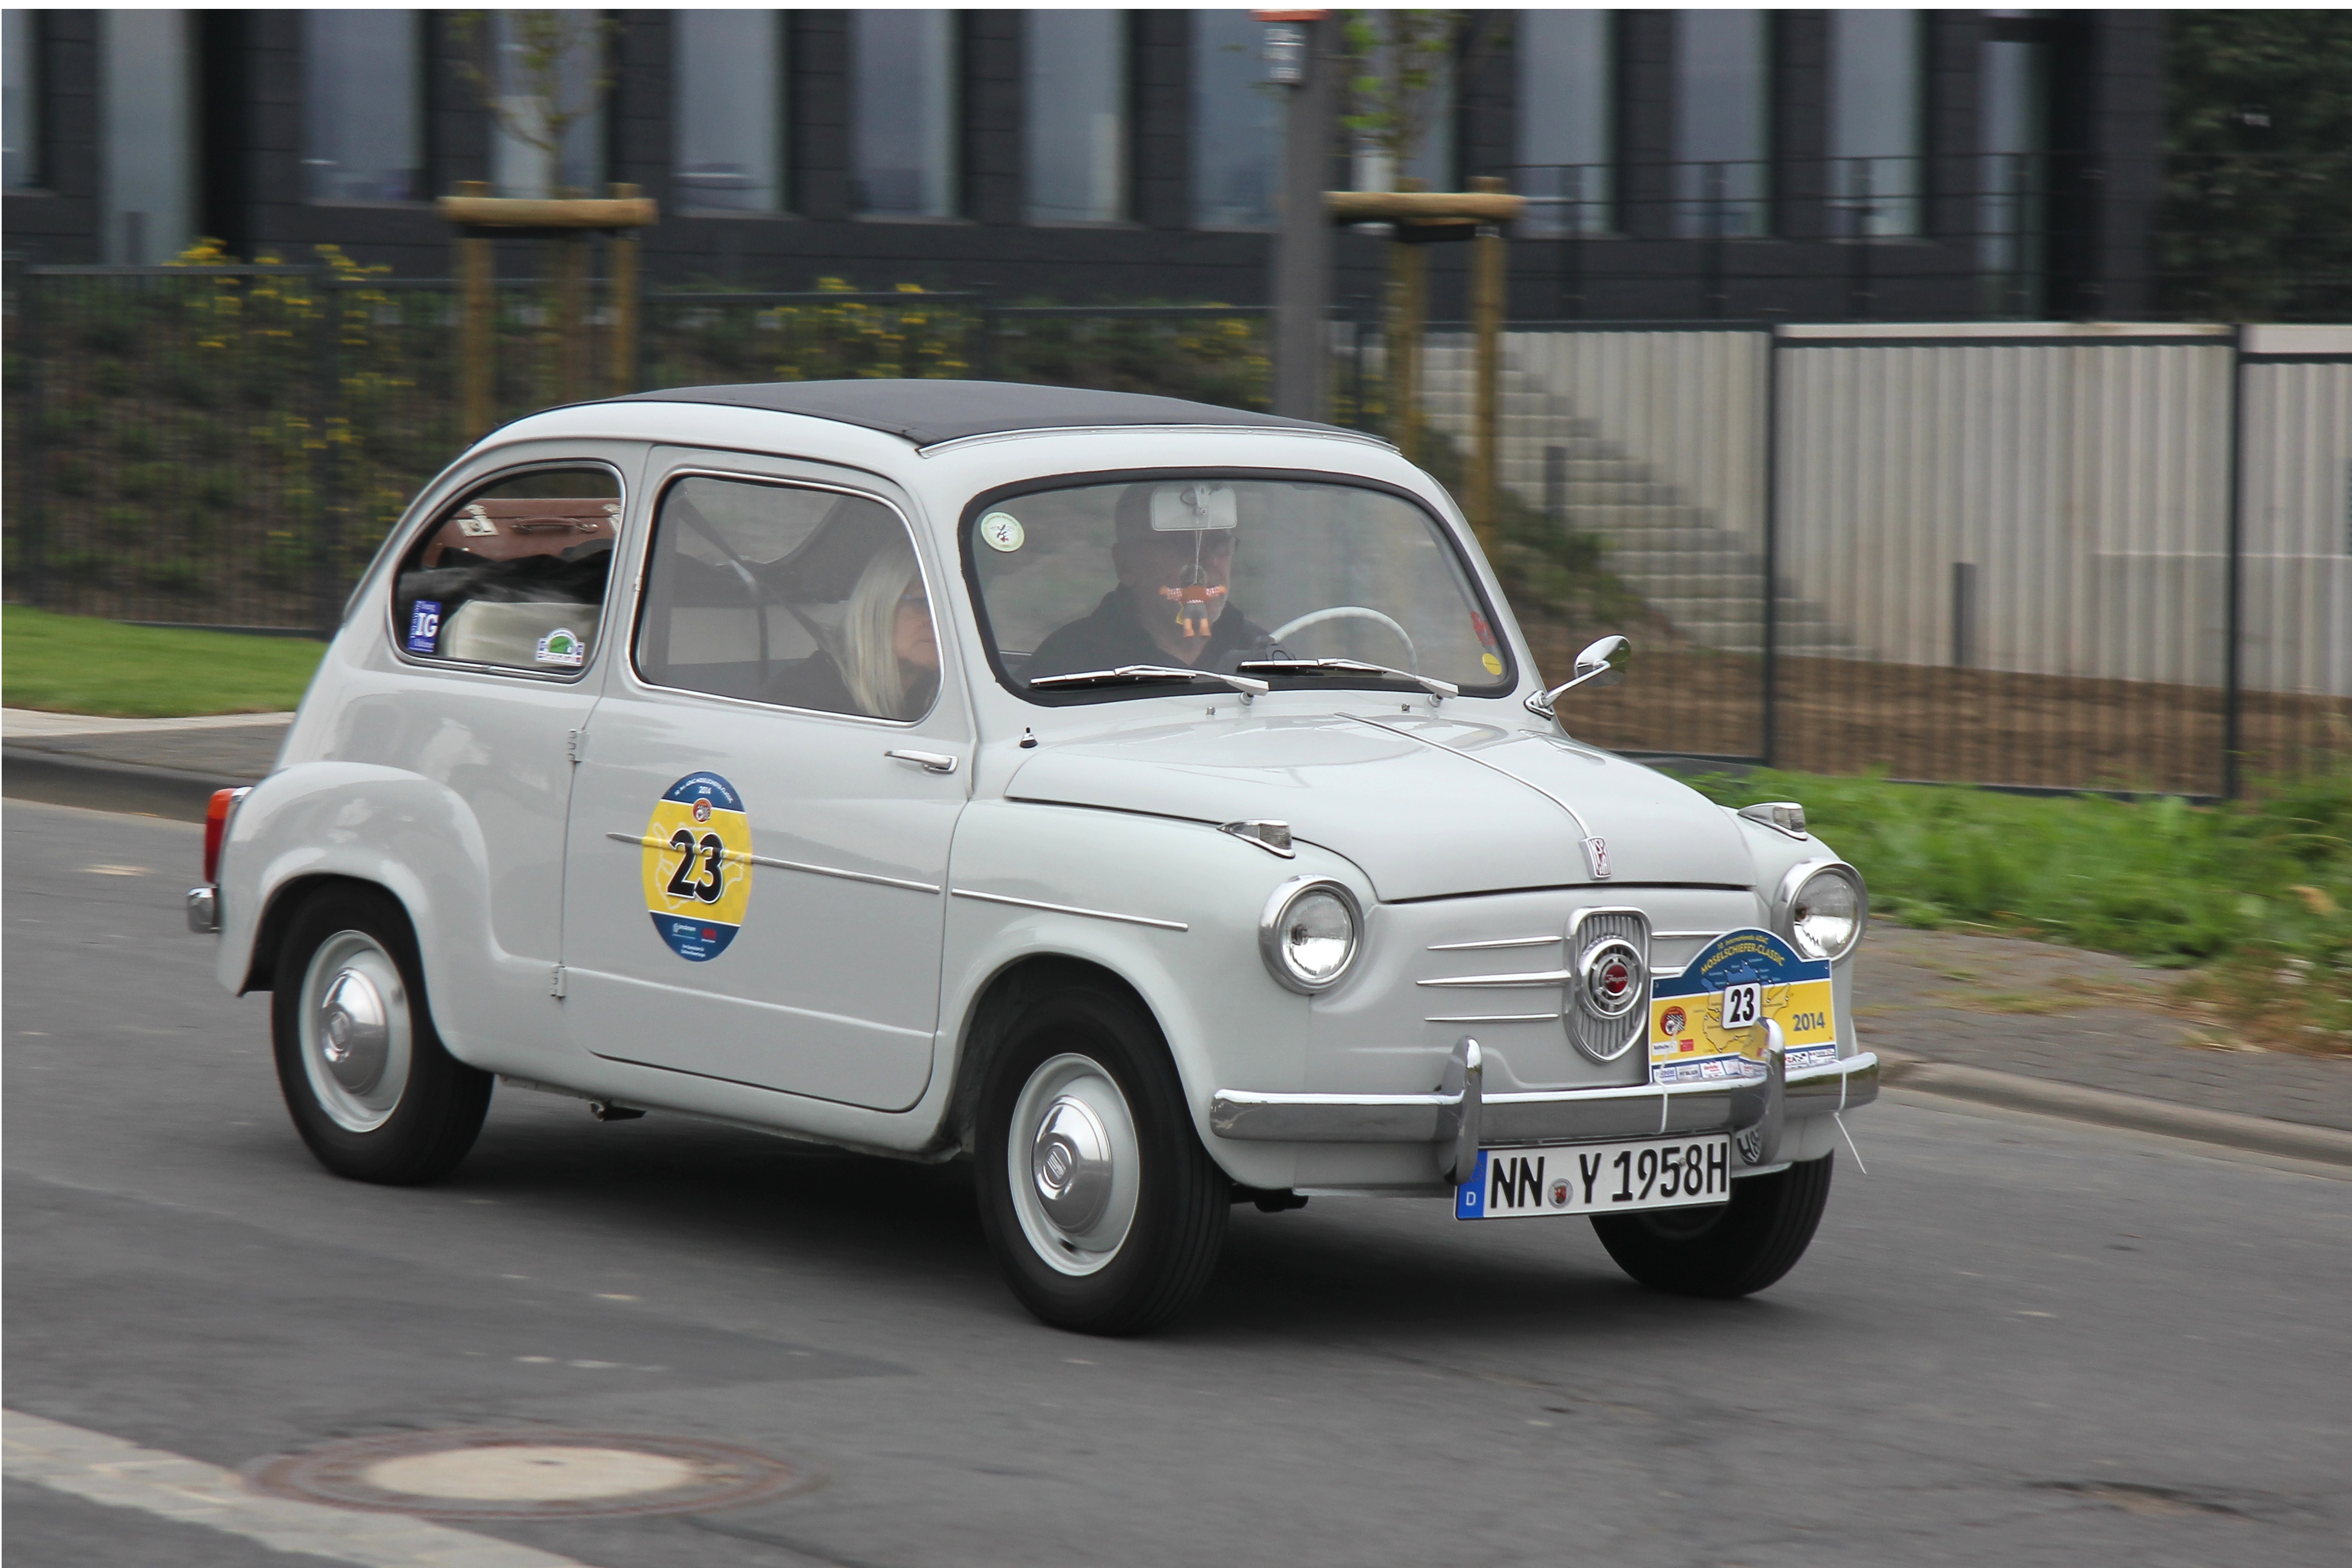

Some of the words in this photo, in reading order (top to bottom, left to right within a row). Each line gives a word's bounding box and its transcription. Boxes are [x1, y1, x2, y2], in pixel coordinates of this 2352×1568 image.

[416, 612, 439, 638] IG
[697, 786, 712, 795] 2014
[667, 828, 723, 903] 23
[1729, 987, 1755, 1022] 23
[1793, 1012, 1826, 1032] 2014
[1491, 1156, 1545, 1208] NN
[1579, 1152, 1602, 1204] Y
[1612, 1142, 1727, 1202] 1958H
[1466, 1191, 1476, 1206] D
